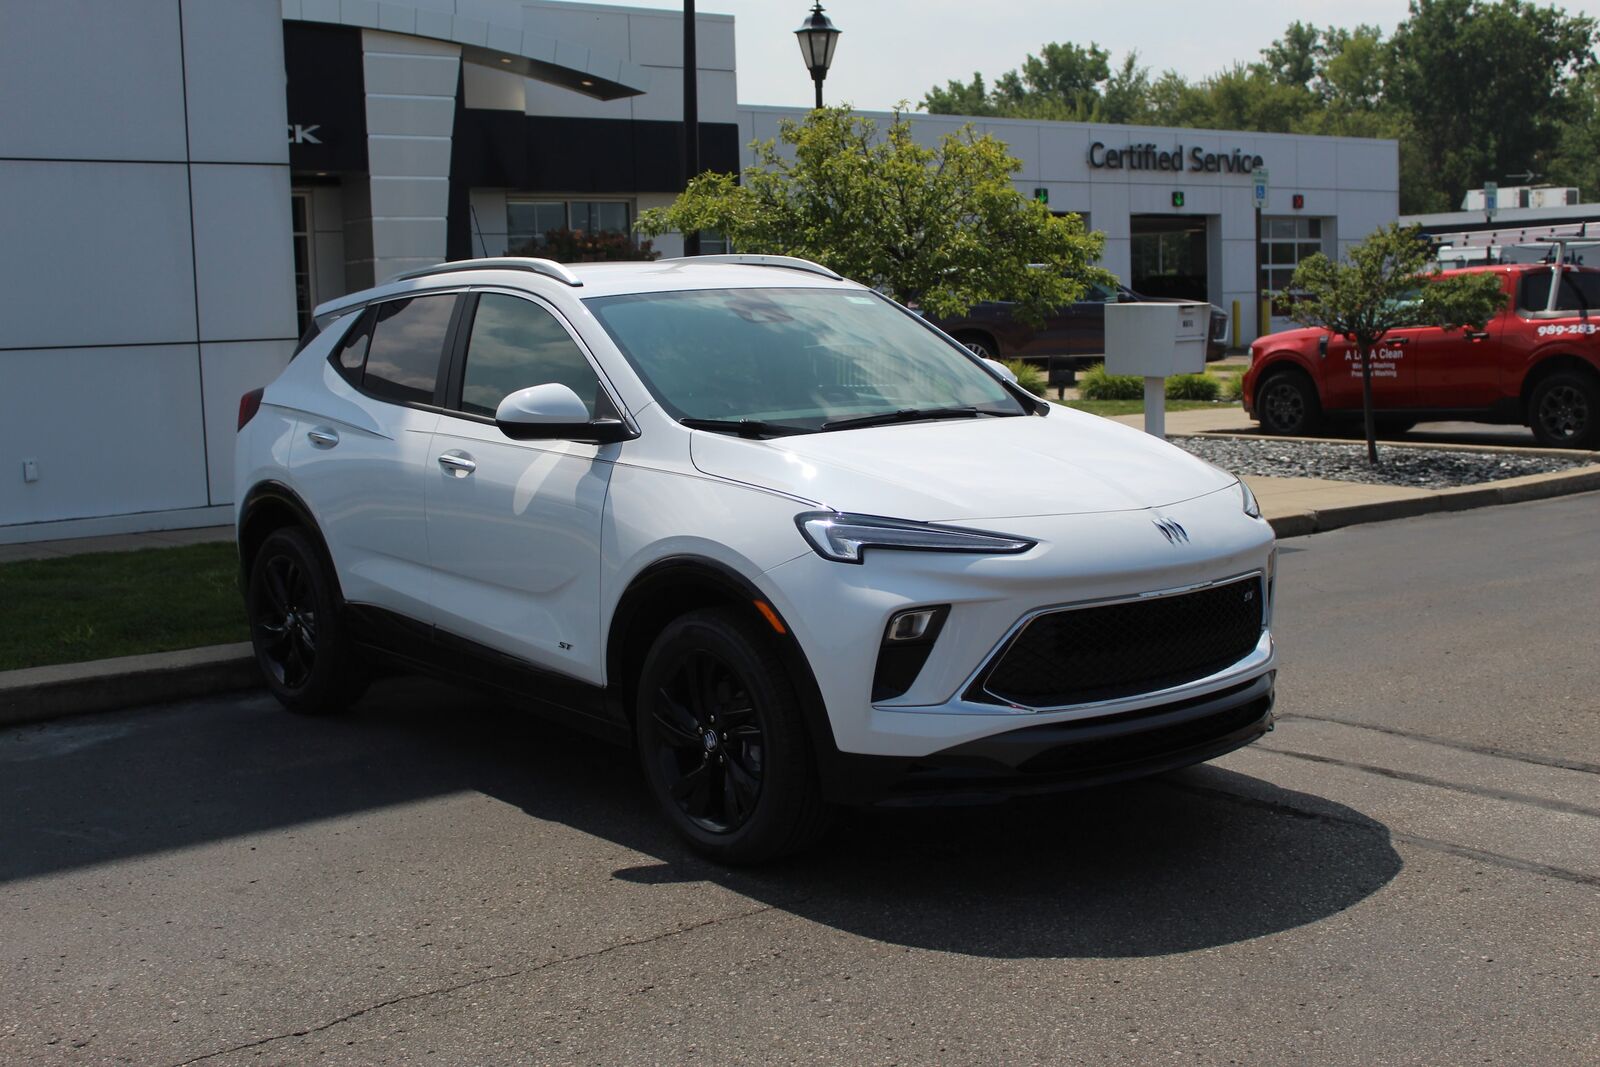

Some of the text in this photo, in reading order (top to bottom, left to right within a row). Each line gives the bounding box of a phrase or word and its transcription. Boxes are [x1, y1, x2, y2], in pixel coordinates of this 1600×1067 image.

[1088, 141, 1264, 174] Certified Service
[1345, 350, 1352, 360] A
[1370, 349, 1377, 359] A
[1379, 348, 1403, 359] Clean
[558, 641, 574, 650] ST
